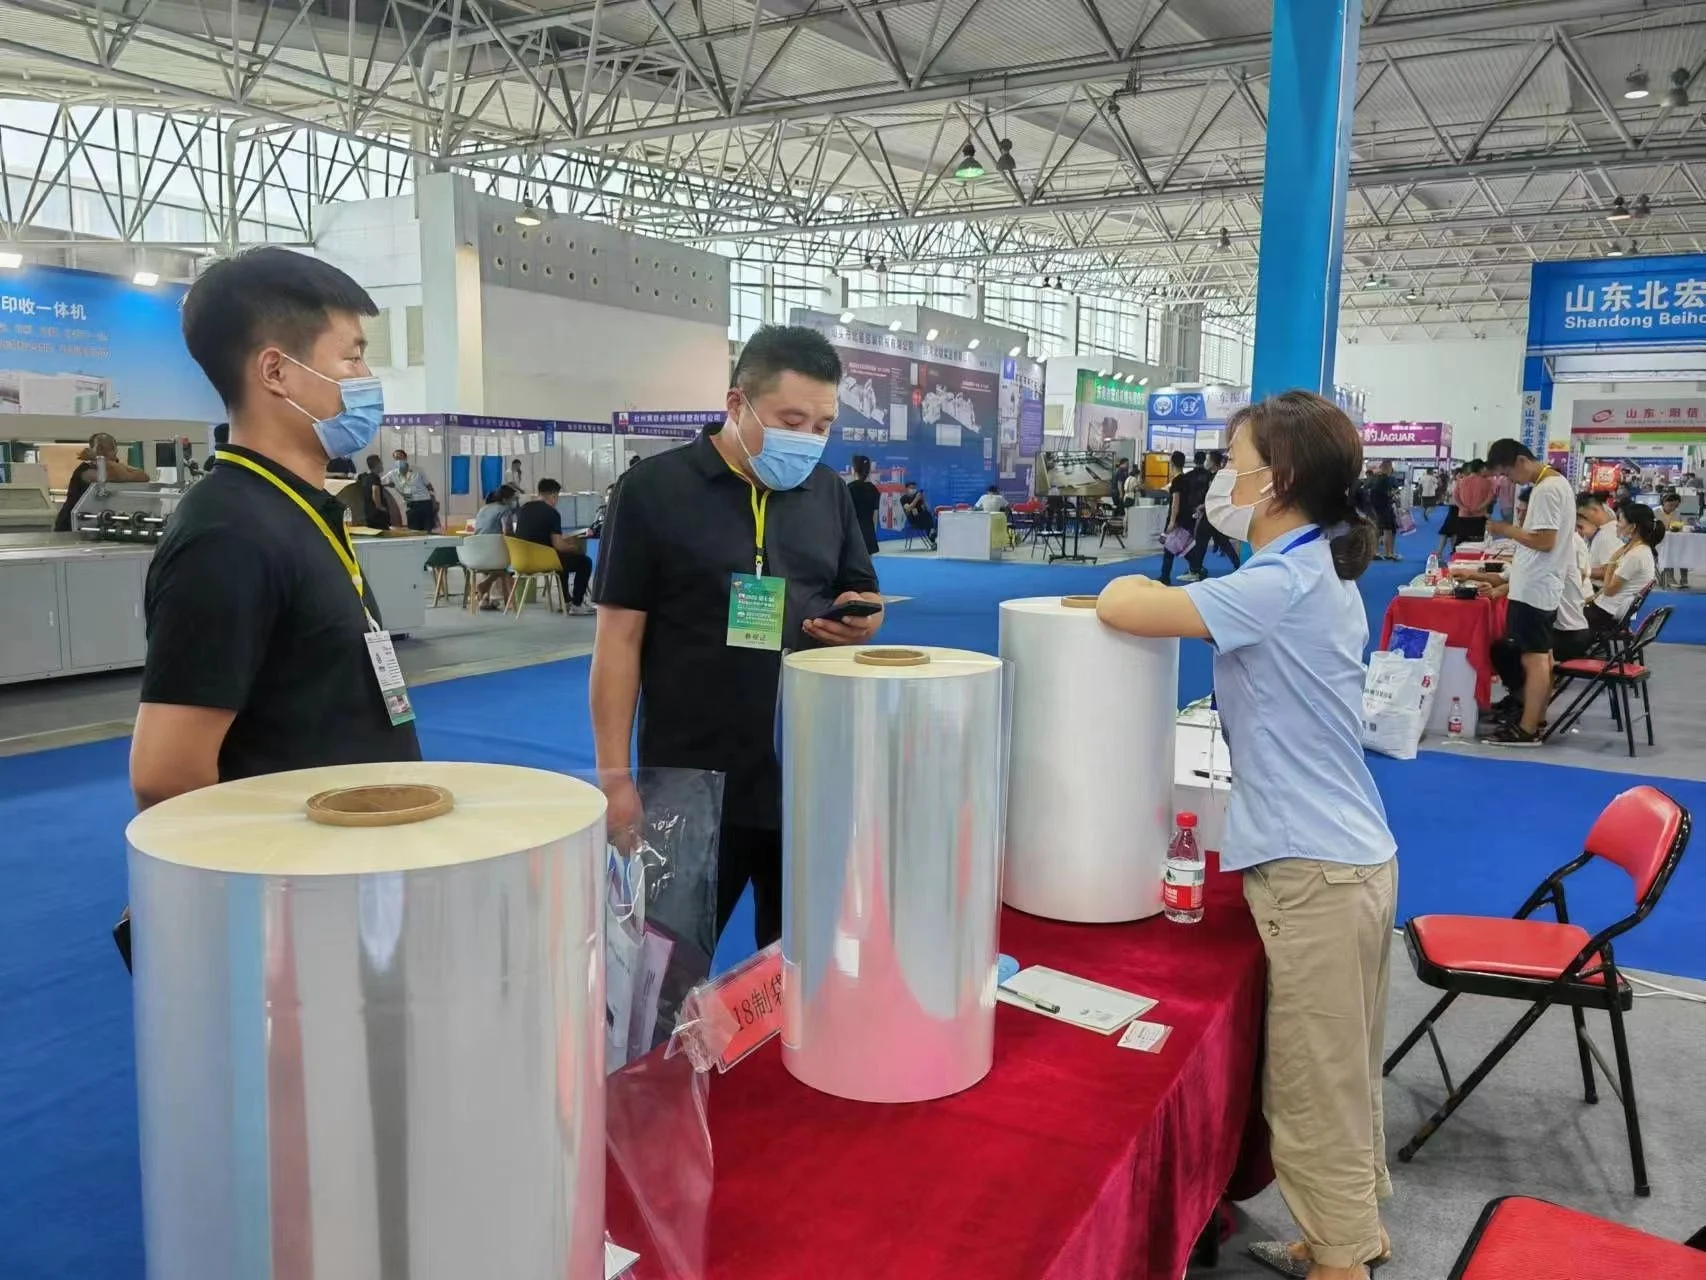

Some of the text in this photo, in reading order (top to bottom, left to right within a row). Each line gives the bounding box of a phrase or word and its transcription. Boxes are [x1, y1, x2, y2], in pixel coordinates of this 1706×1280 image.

[1565, 278, 1706, 312] 山东北宏
[1, 295, 87, 320] 印收一体机
[1564, 314, 1653, 328] Shandong
[1379, 430, 1416, 442] JAGUAR
